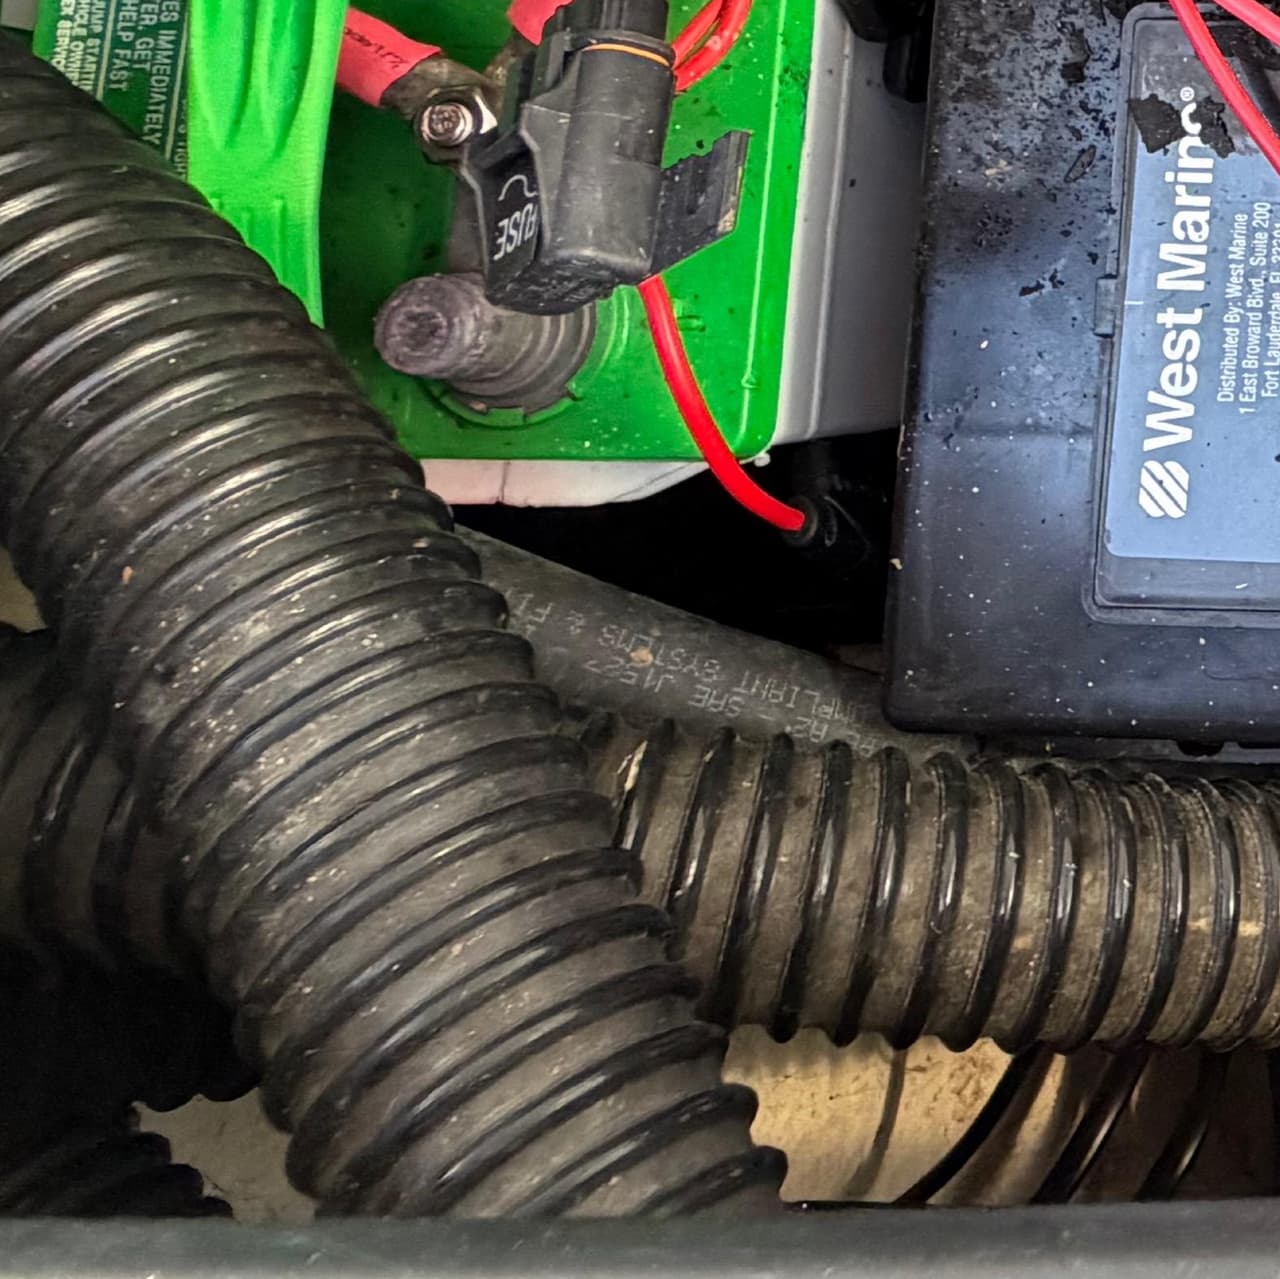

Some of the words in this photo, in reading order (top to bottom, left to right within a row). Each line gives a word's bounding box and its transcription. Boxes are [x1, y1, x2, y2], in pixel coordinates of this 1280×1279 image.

[118, 0, 138, 41] HELP
[109, 49, 130, 91] FAST
[132, 38, 151, 71] GET
[142, 30, 177, 145] IMMEDIATELY
[1252, 202, 1271, 228] 200
[1229, 214, 1248, 260] Marine
[1247, 231, 1269, 266] Suite
[1225, 263, 1244, 297] West
[1245, 270, 1267, 308] Blvd.,
[1223, 301, 1244, 323] By:
[1242, 311, 1262, 369] Broward
[1142, 307, 1205, 451] West
[1217, 327, 1241, 402] Distributed
[1263, 370, 1280, 397] Fort
[1241, 372, 1258, 402] East
